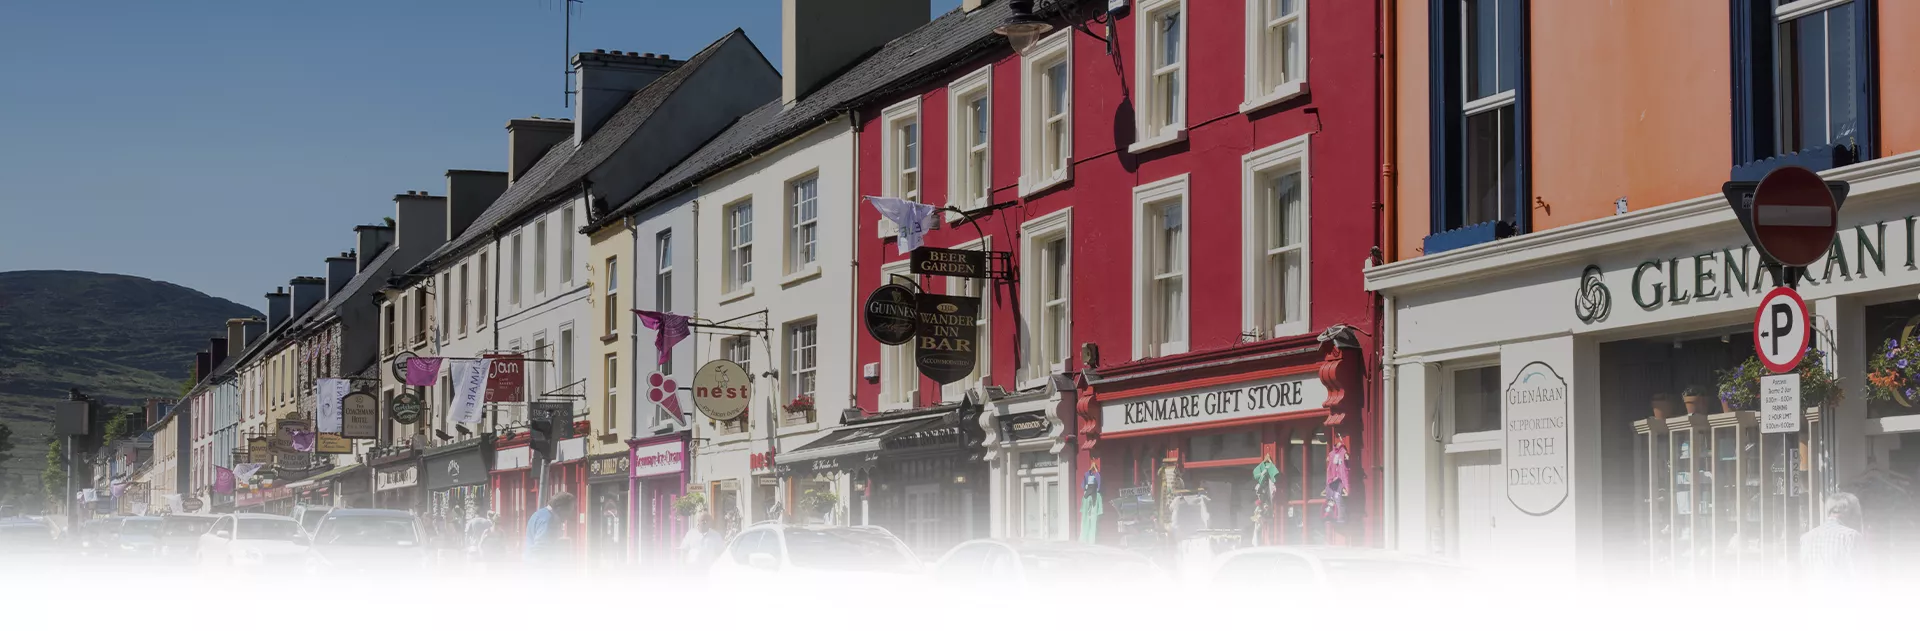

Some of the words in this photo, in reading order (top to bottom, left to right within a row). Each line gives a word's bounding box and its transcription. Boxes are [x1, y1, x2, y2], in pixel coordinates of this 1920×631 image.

[930, 251, 966, 263] BEER
[921, 260, 975, 274] GARDEN
[920, 312, 974, 326] WANDER
[934, 326, 959, 337] INN
[1772, 303, 1794, 356] P
[920, 336, 972, 352] BAR
[696, 384, 748, 399] nest
[1509, 386, 1563, 405] GLENARAN
[1124, 394, 1200, 425] KENMARE
[1204, 389, 1242, 416] GIFT
[1247, 381, 1303, 410] STORE
[1510, 416, 1564, 432] SUPPORTING
[1518, 437, 1555, 457] IRISH
[1510, 466, 1564, 486] DESIGN
